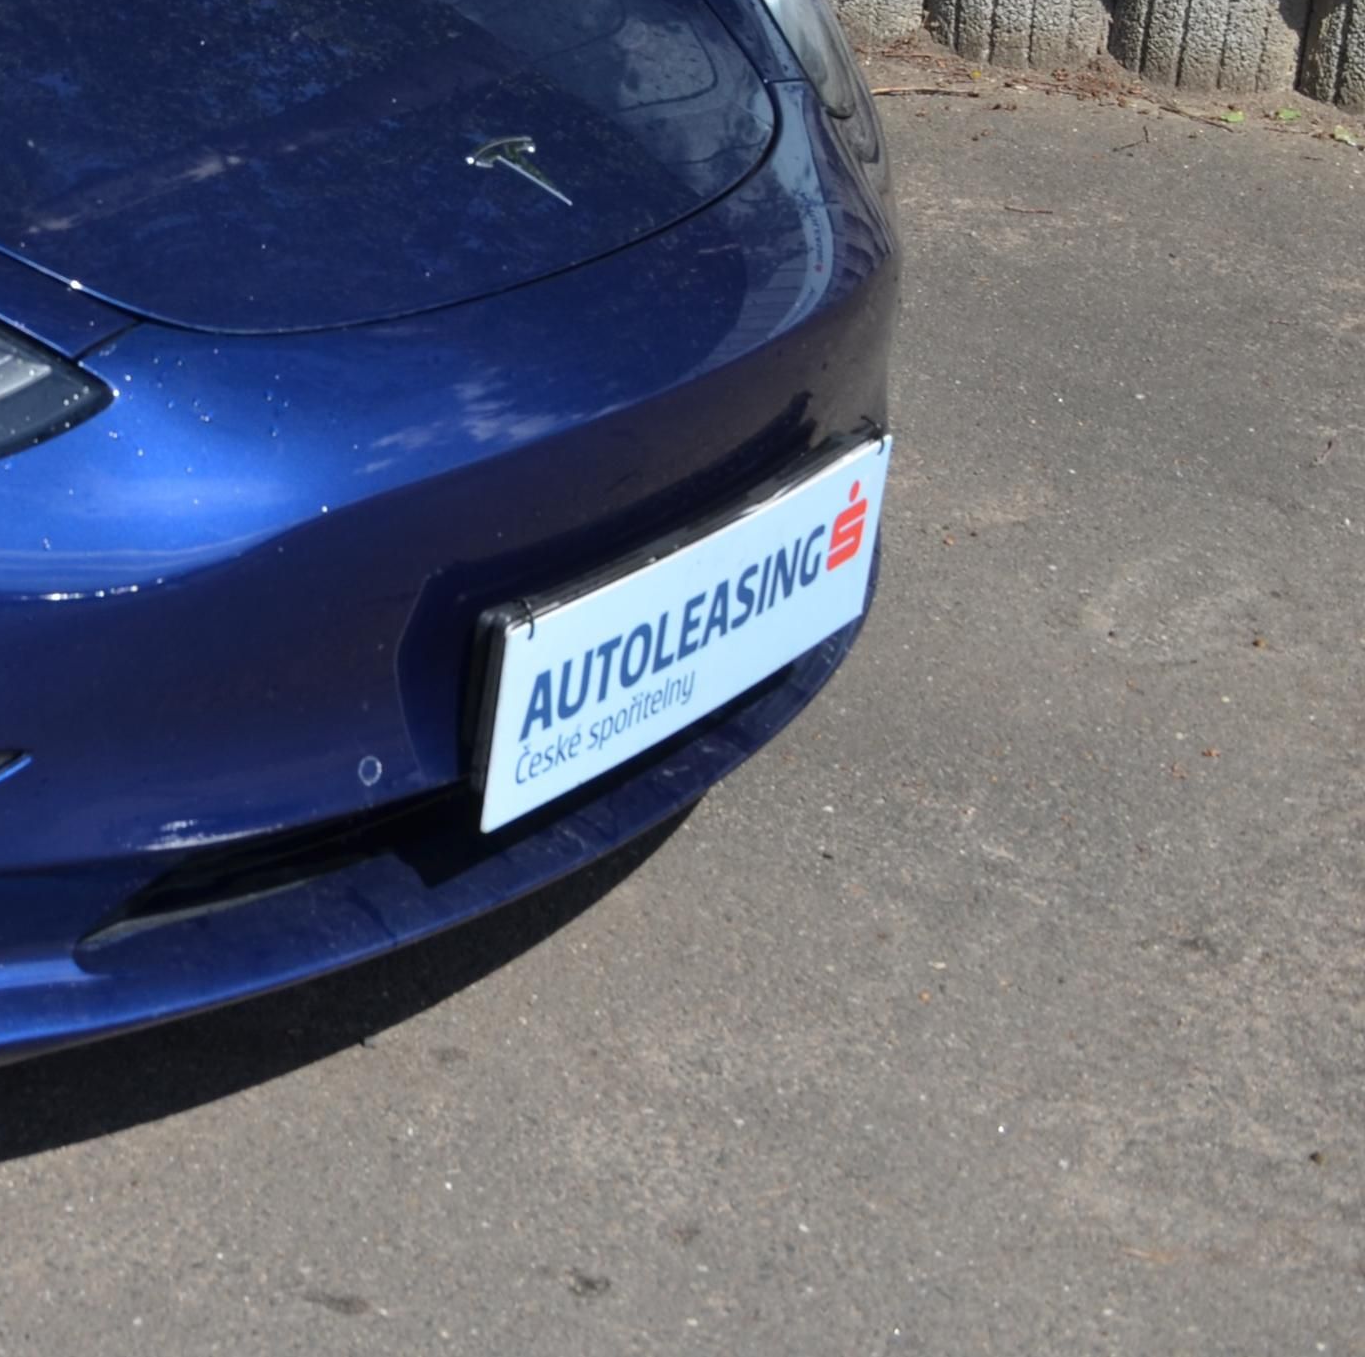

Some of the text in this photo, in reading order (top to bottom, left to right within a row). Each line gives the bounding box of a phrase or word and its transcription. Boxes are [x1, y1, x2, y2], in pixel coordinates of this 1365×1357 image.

[518, 524, 826, 743] AUTOLEASING
[514, 670, 696, 787] České spořitelny
